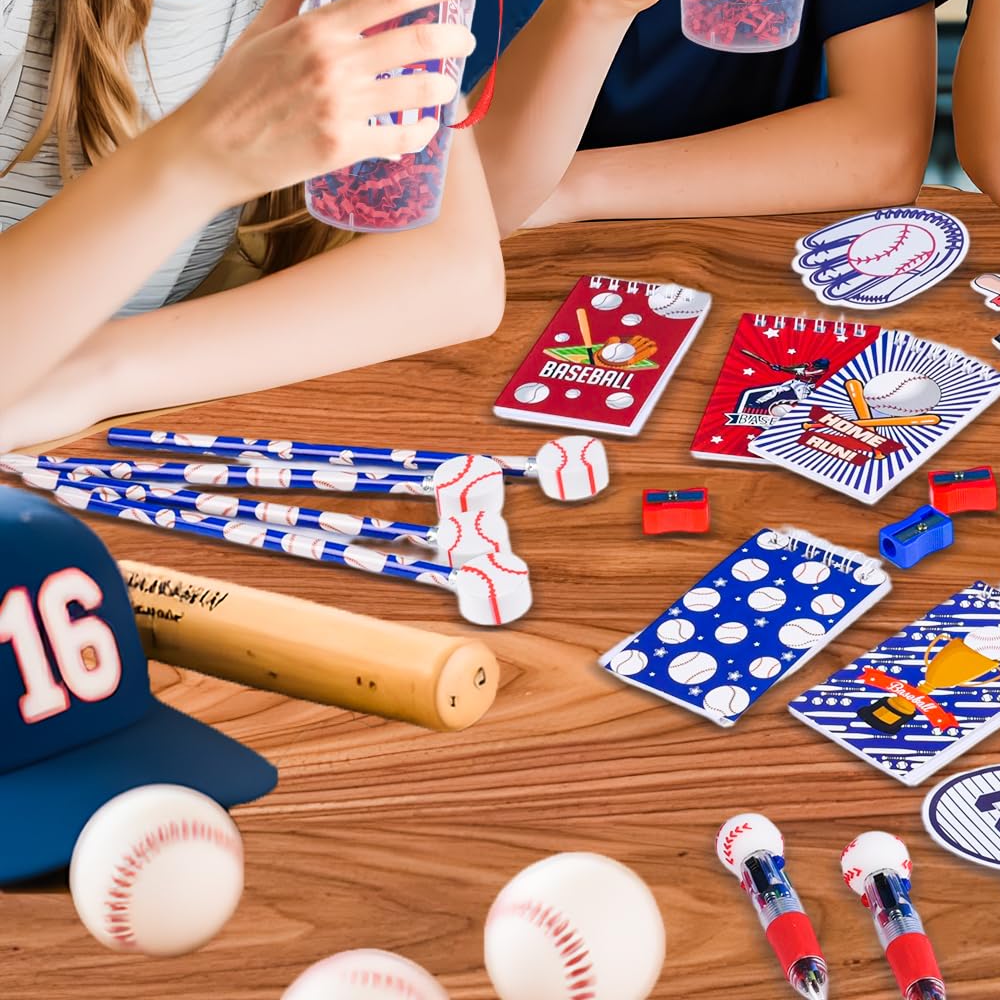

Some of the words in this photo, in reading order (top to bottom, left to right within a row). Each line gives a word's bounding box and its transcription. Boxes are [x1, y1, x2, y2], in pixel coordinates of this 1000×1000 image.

[539, 360, 635, 390] BASEBALL
[818, 413, 887, 448] HOME
[806, 435, 858, 462] RUN!
[0, 566, 122, 725] 16
[886, 681, 938, 713] Baseball
